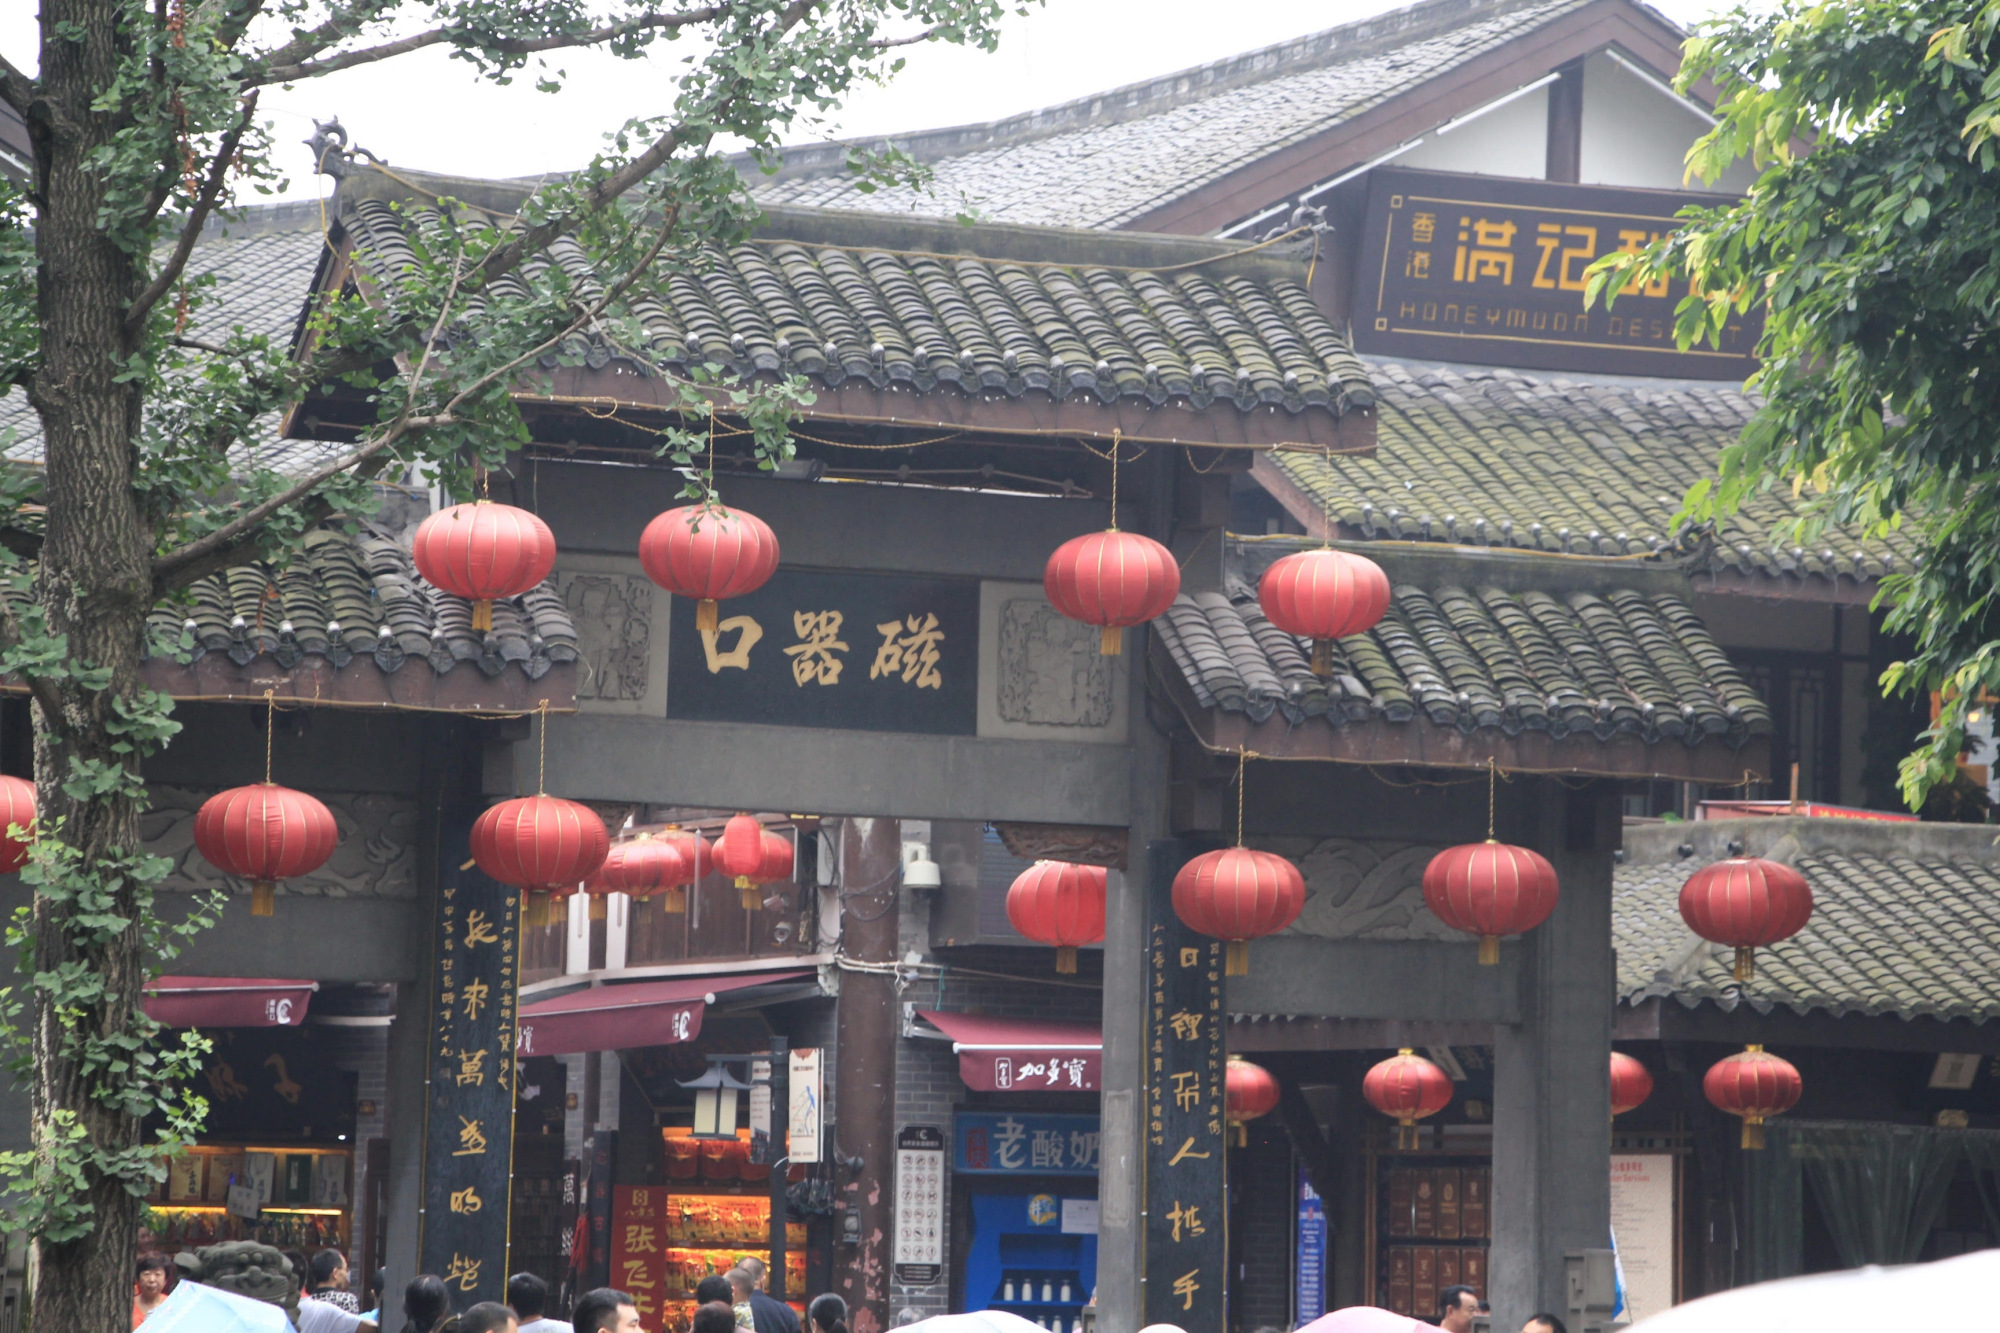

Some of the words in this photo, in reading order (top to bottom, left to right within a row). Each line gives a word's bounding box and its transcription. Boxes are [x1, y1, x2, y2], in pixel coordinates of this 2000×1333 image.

[1405, 212, 1436, 279] 香港
[993, 1116, 1099, 1169] 老酸奶
